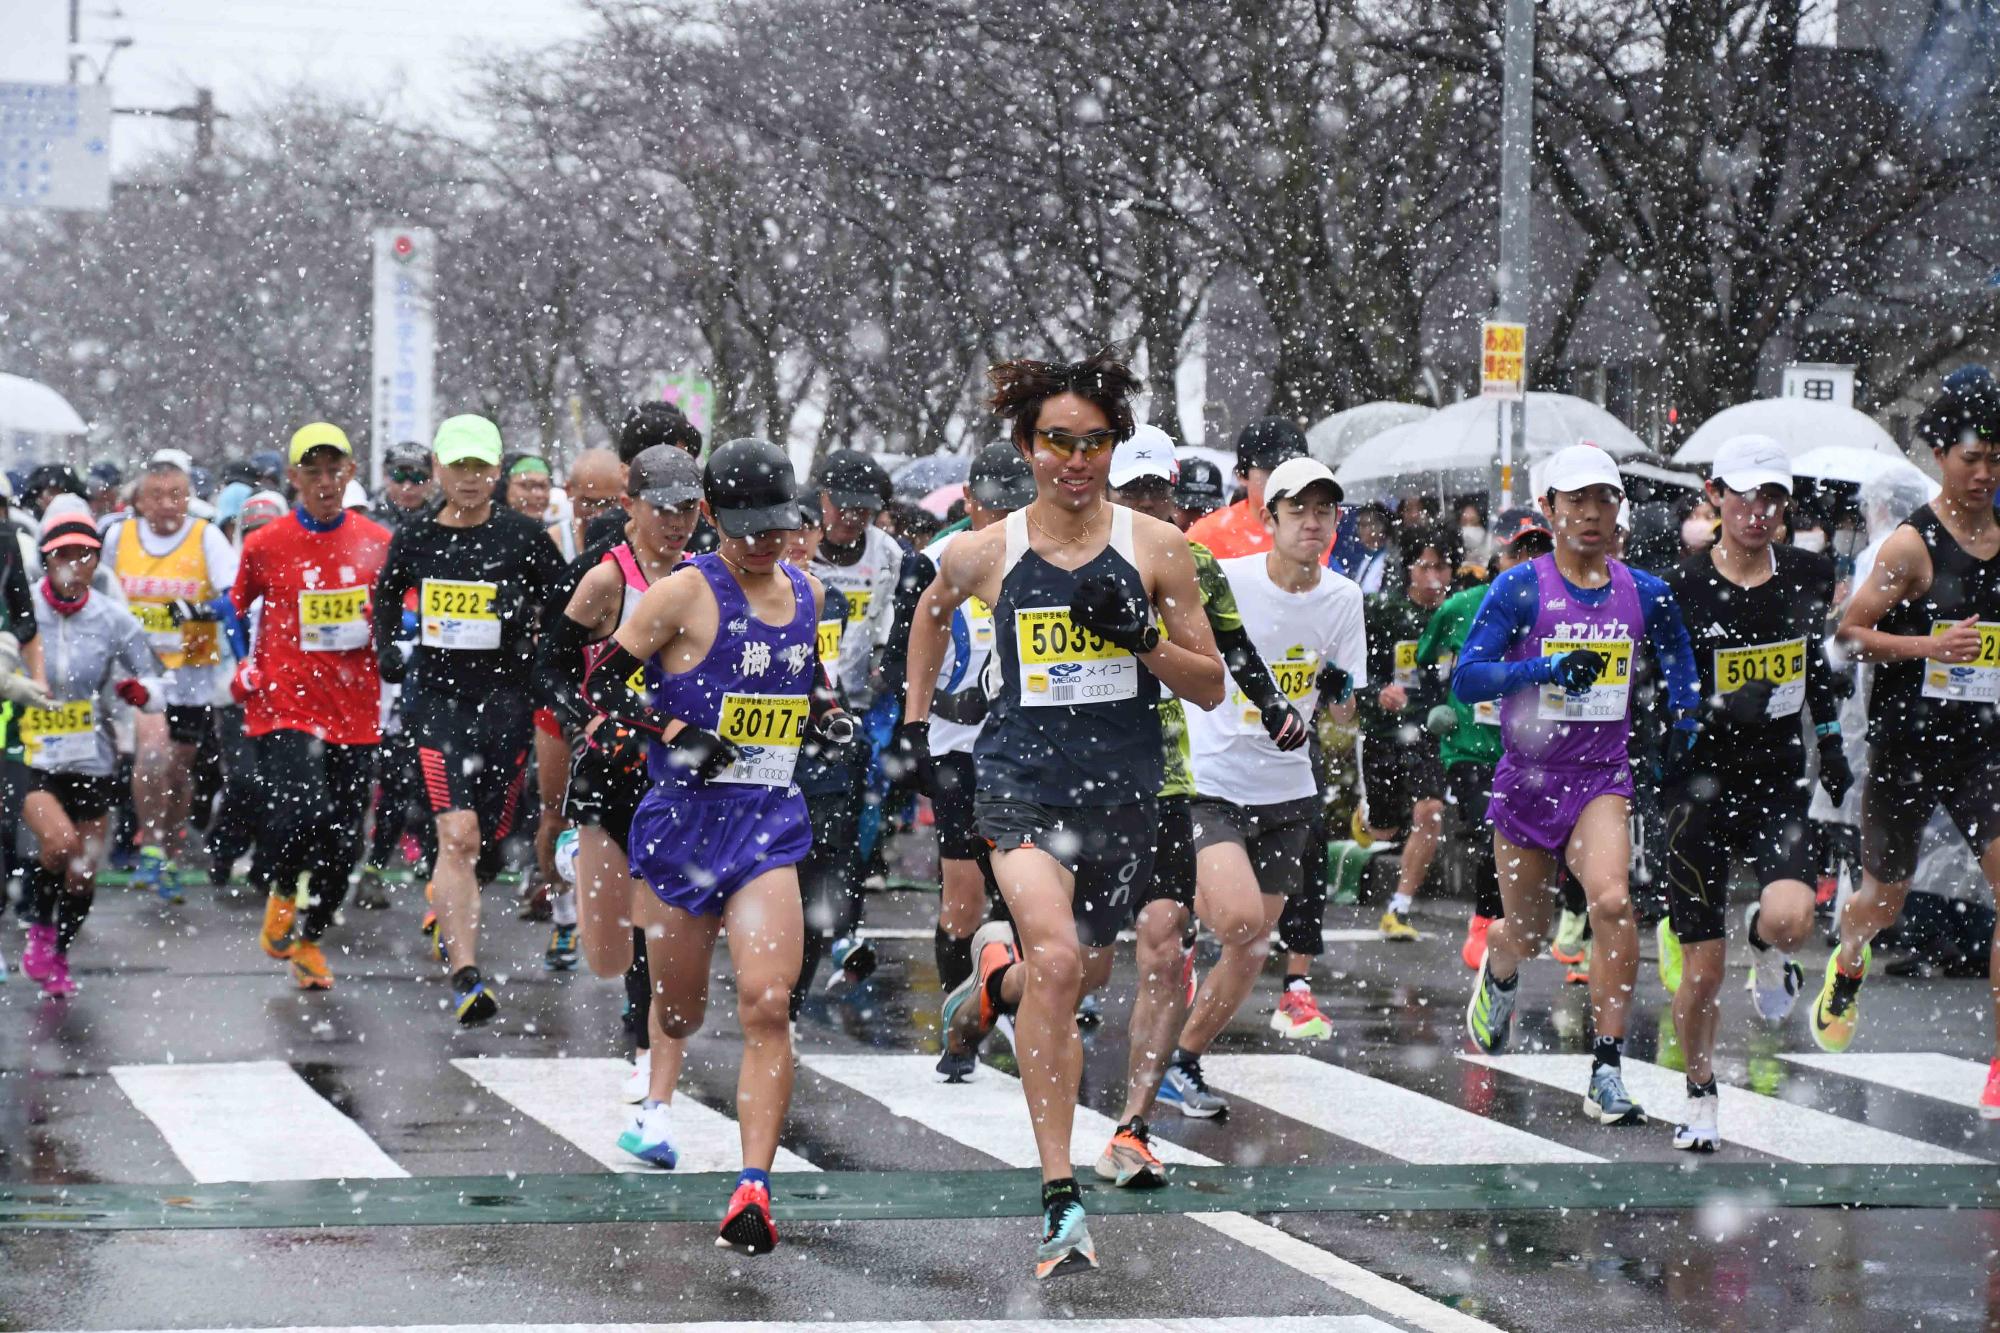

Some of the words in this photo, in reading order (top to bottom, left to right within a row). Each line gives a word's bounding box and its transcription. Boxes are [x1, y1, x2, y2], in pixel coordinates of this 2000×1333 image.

[310, 598, 353, 619] 5424
[431, 591, 480, 613] 5222
[1086, 665, 1134, 677] メイコー
[1727, 654, 1785, 684] 5013
[1053, 676, 1081, 684] MEIKO
[730, 707, 792, 738] 3017
